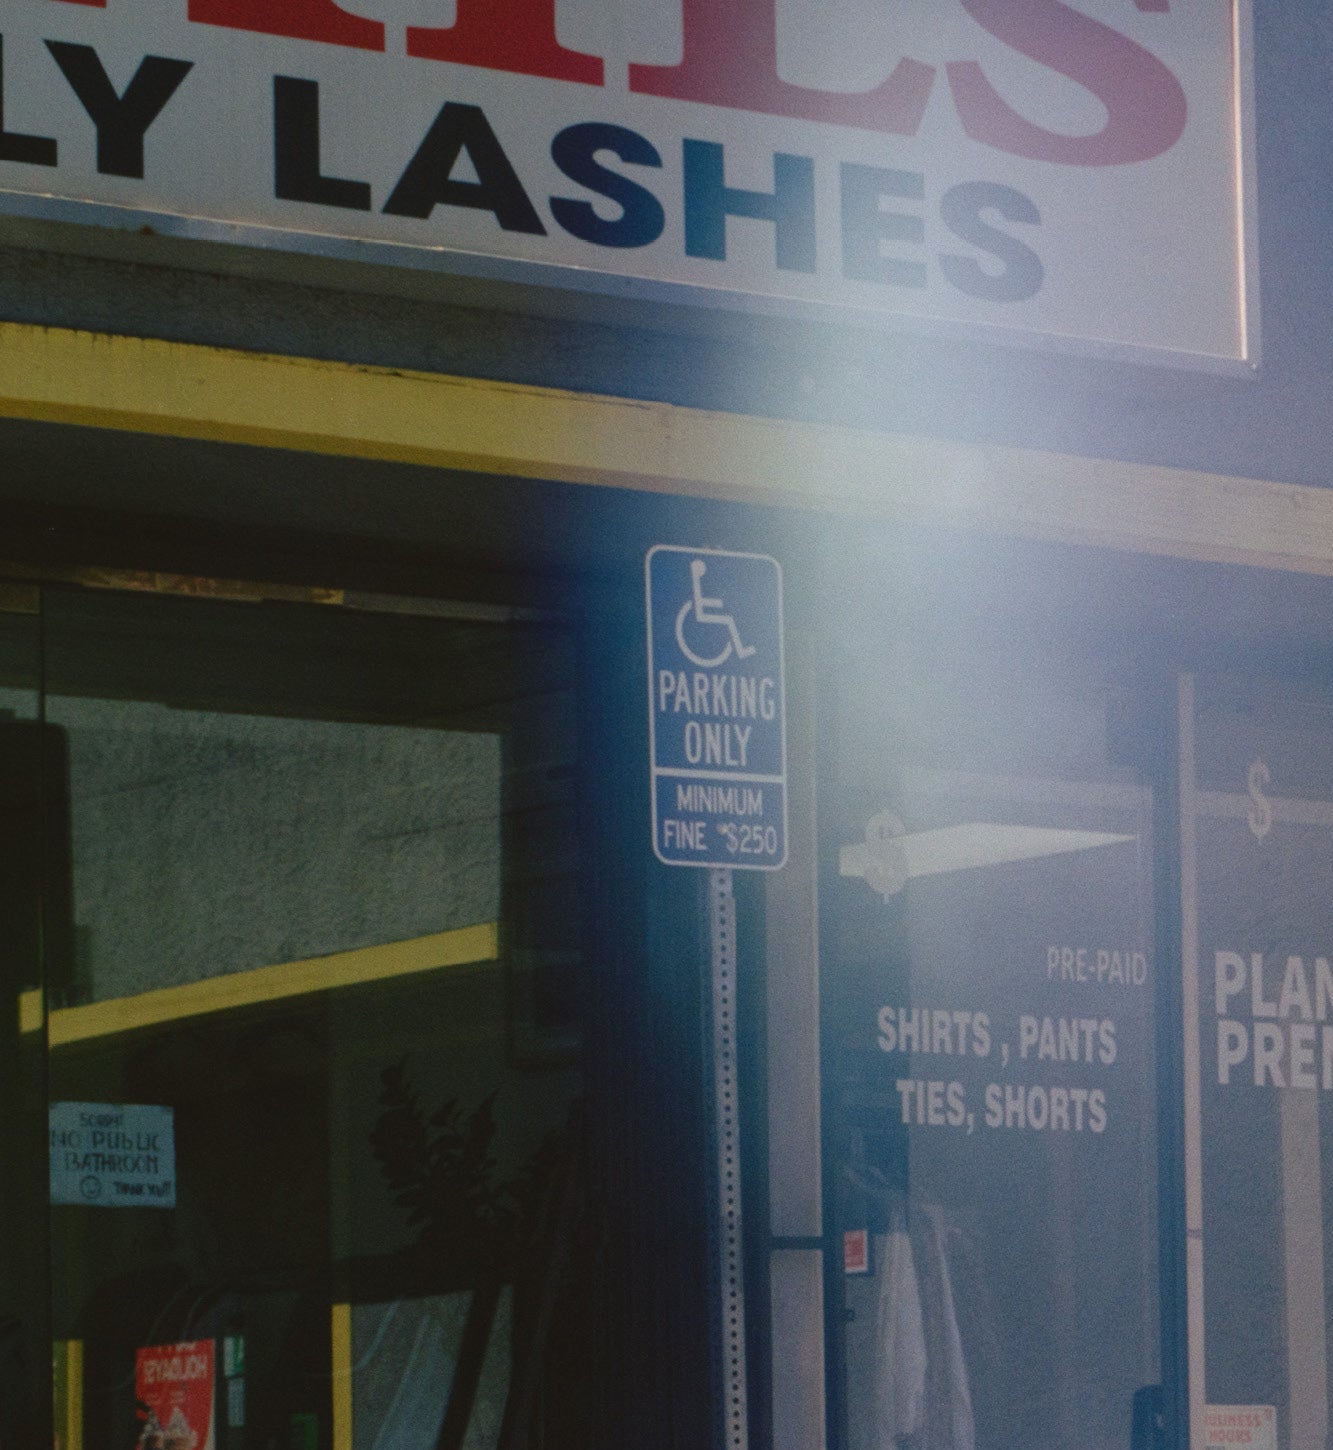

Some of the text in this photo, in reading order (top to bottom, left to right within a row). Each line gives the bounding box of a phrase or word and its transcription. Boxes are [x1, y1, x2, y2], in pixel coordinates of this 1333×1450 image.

[273, 74, 1044, 302] LASHES
[659, 670, 776, 720] PARKING
[685, 721, 752, 767] ONLY
[677, 784, 763, 816] MINIMUM
[663, 819, 778, 855] FINE $250
[1047, 946, 1147, 986] PRE-PAID
[1019, 1016, 1118, 1066] PANTS
[896, 1079, 1108, 1134] TIES, SHORTS
[51, 1130, 82, 1148] NO
[64, 1150, 159, 1174] BATHROOM
